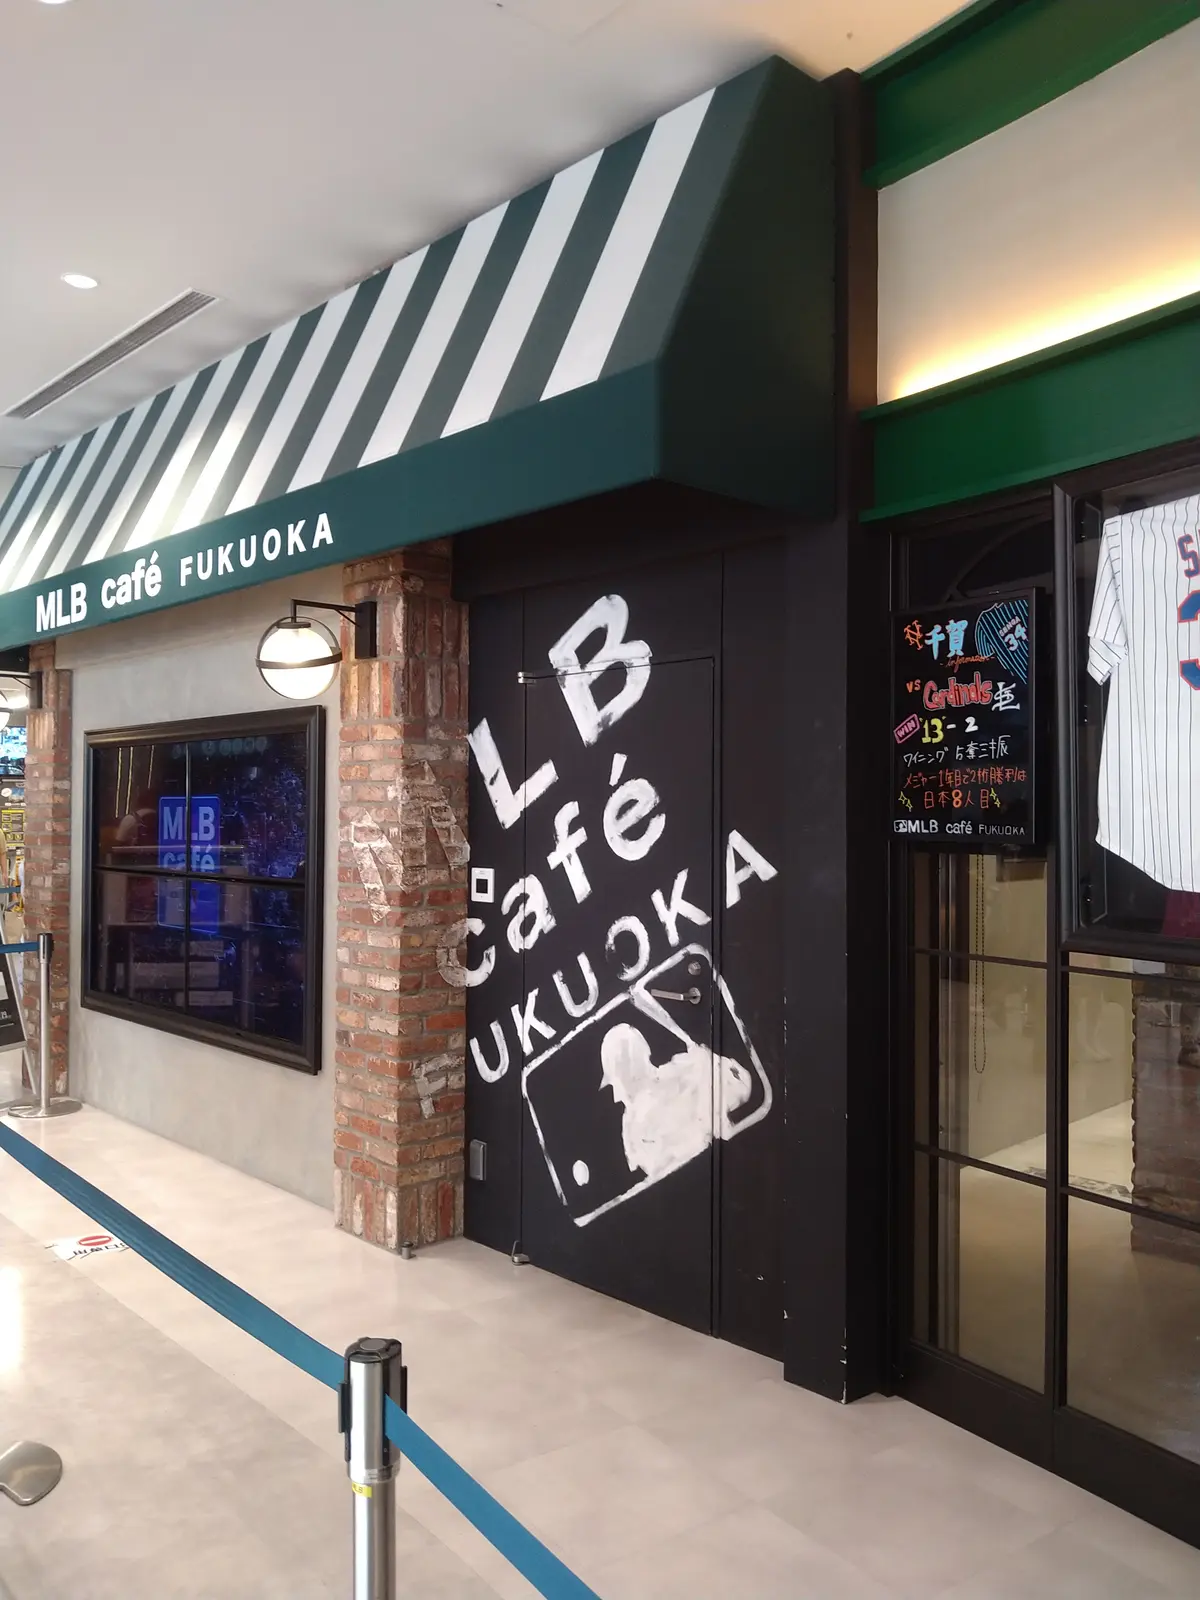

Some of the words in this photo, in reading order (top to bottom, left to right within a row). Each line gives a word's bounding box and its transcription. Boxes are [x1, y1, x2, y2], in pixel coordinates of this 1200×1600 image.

[36, 582, 87, 633] MLB
[101, 550, 162, 609] café
[180, 512, 334, 587] FUKUOKA
[1178, 533, 1200, 578] S
[924, 619, 969, 660] 千賀
[1004, 624, 1027, 651] 34
[923, 671, 993, 711] Cardinals
[896, 719, 917, 738] WIN
[965, 716, 978, 733] 2
[350, 594, 652, 924] MLB
[908, 820, 939, 834] MLB
[945, 821, 973, 835] café
[979, 824, 1025, 836] FUKUOKA
[435, 752, 666, 988] café
